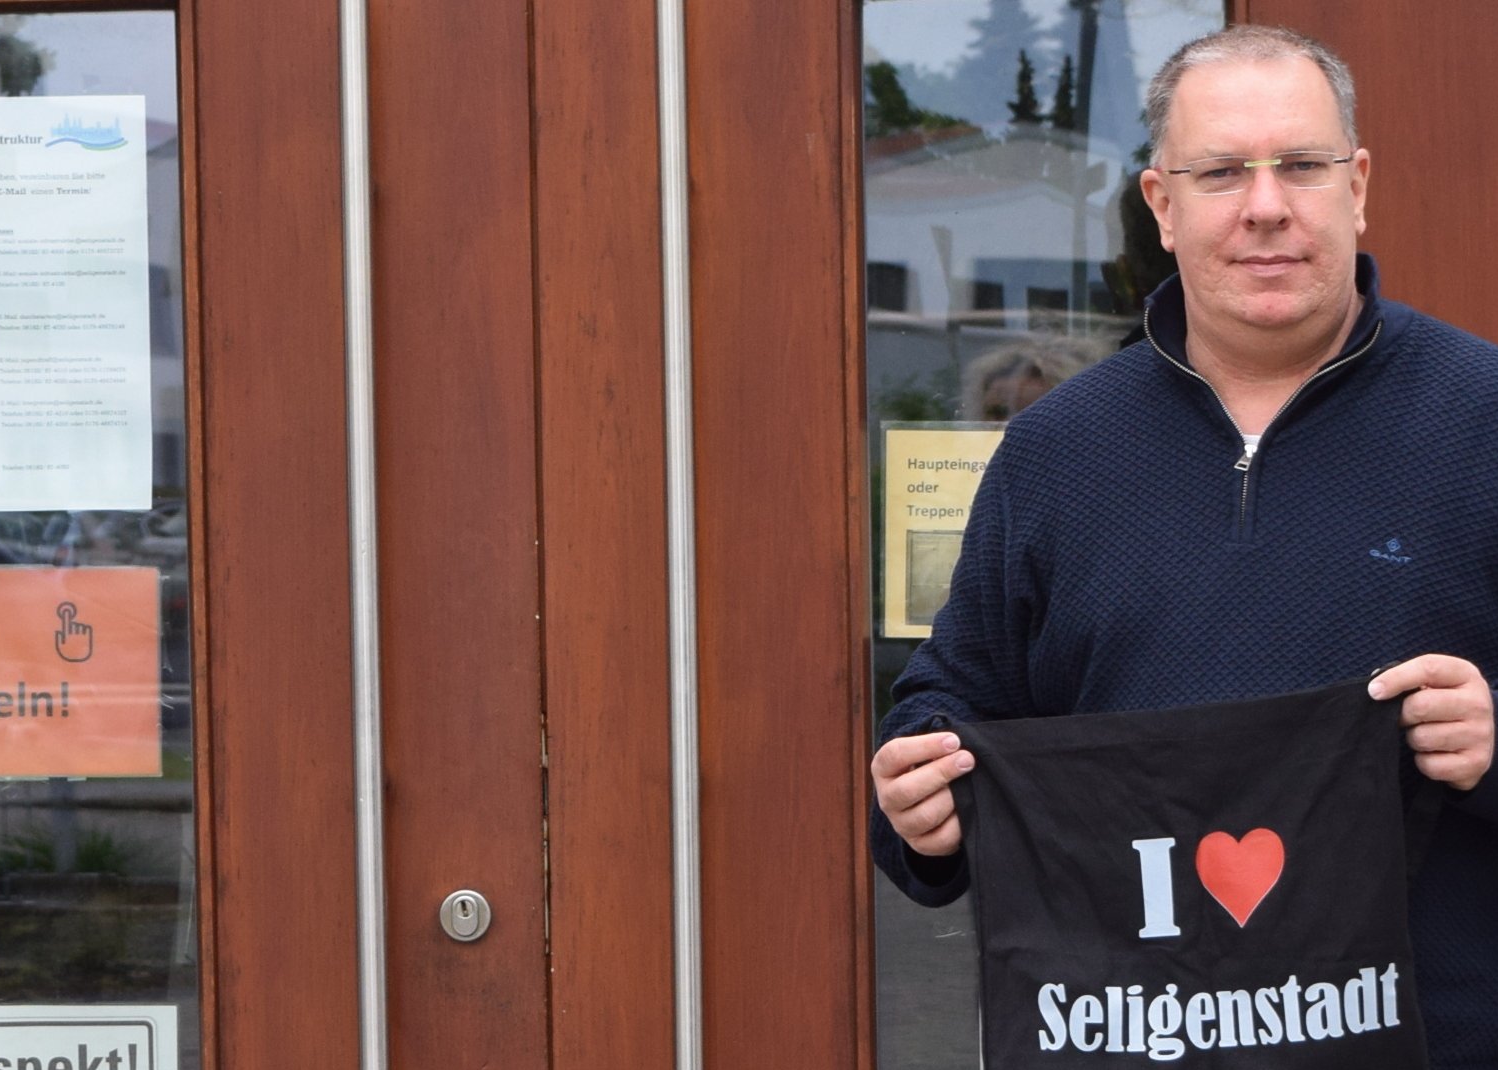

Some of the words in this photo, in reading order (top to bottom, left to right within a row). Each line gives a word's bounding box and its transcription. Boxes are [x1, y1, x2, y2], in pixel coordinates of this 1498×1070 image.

[907, 481, 939, 494] oder
[906, 505, 964, 520] Treppen
[1369, 549, 1412, 564] GANT
[1132, 837, 1181, 939] I
[1036, 962, 1401, 1062] Seligenstadt
